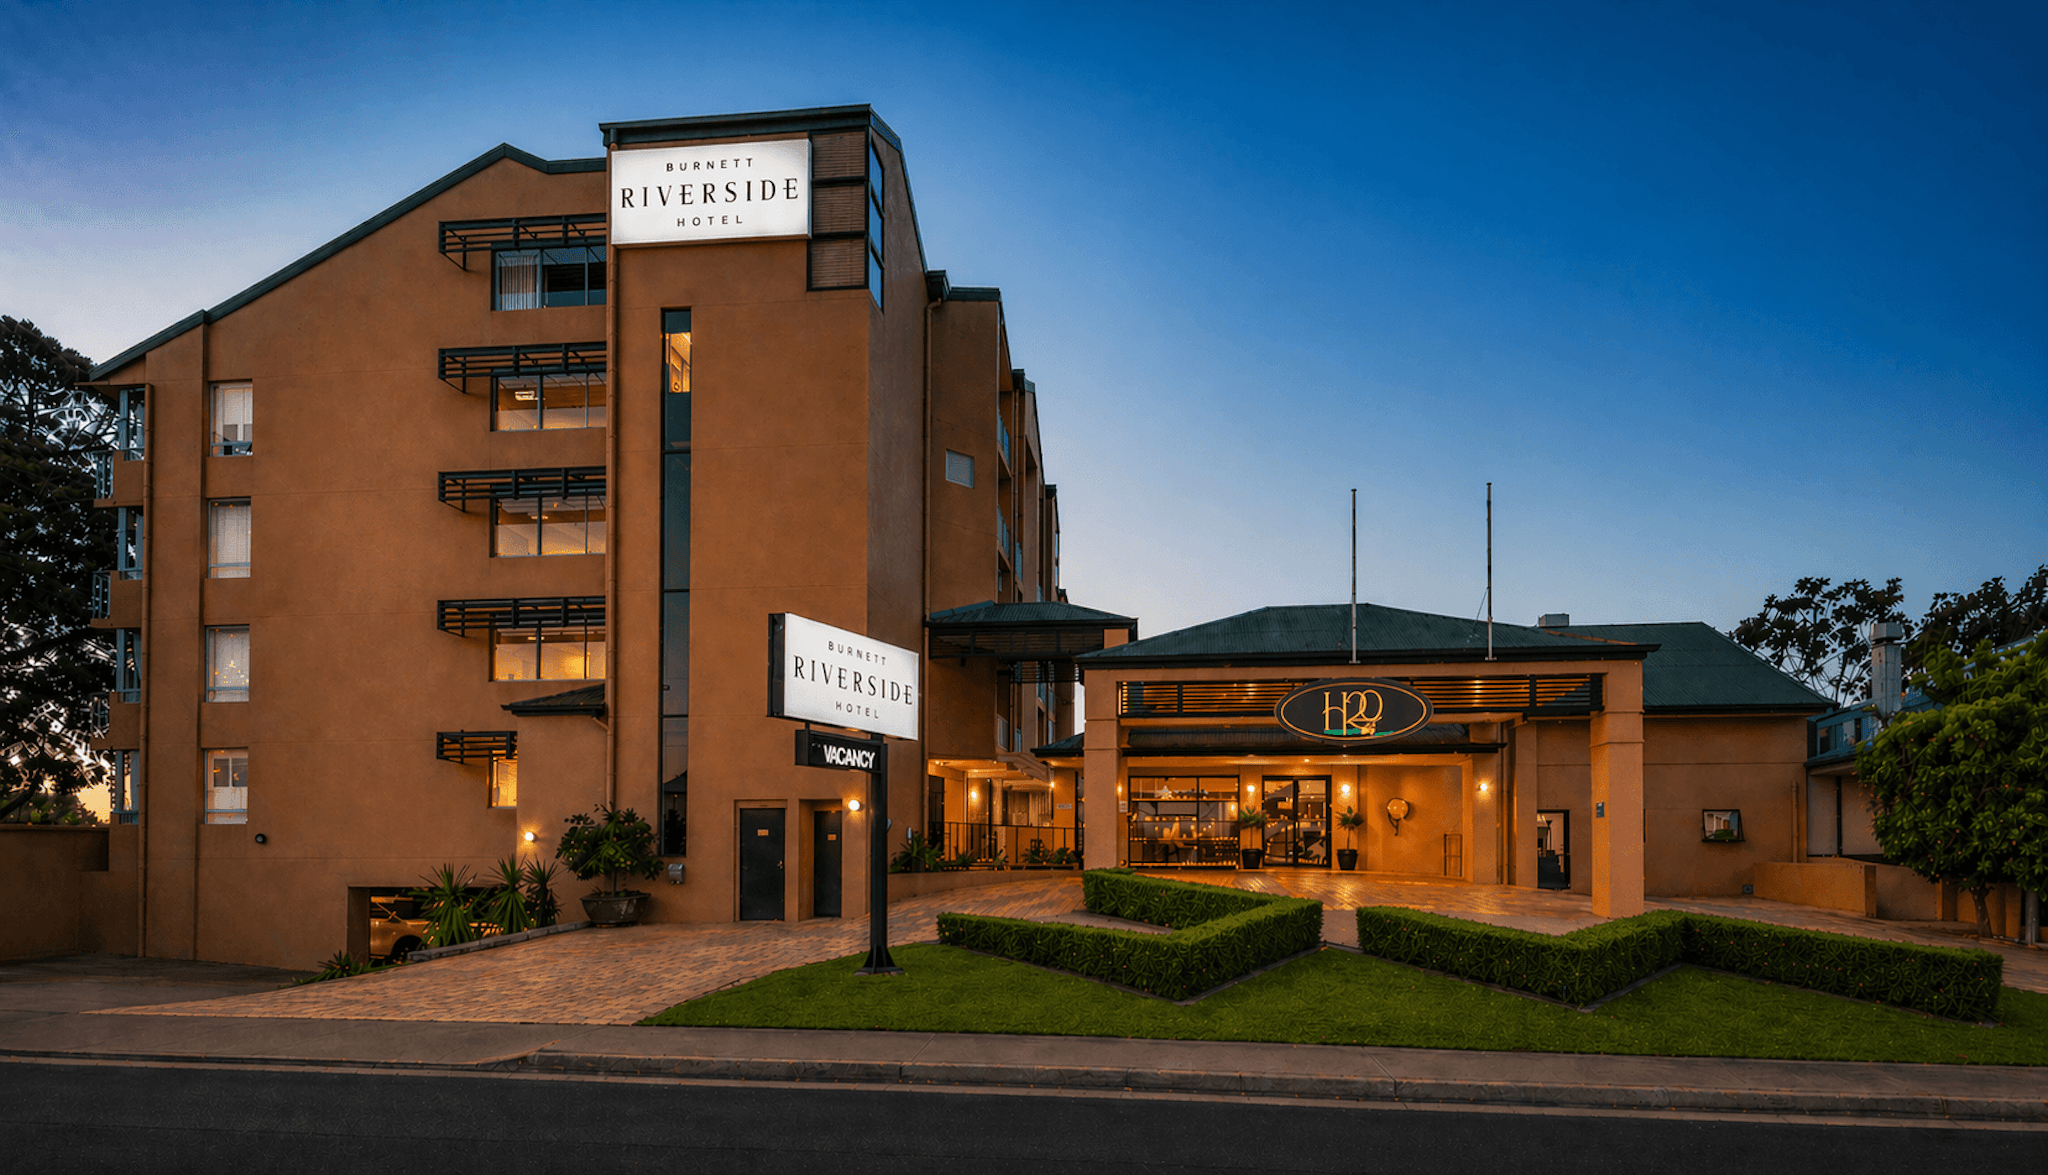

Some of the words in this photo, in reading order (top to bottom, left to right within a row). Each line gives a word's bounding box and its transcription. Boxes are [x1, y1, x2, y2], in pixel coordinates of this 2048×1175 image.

[666, 158, 753, 172] BURNETT
[621, 178, 799, 208] RIVERSIDE
[677, 215, 743, 227] HOTEL
[828, 641, 886, 665] BURNETT
[794, 655, 913, 705] RIVERSIDE
[836, 701, 879, 718] HOTEL
[823, 744, 876, 769] VACANCY
